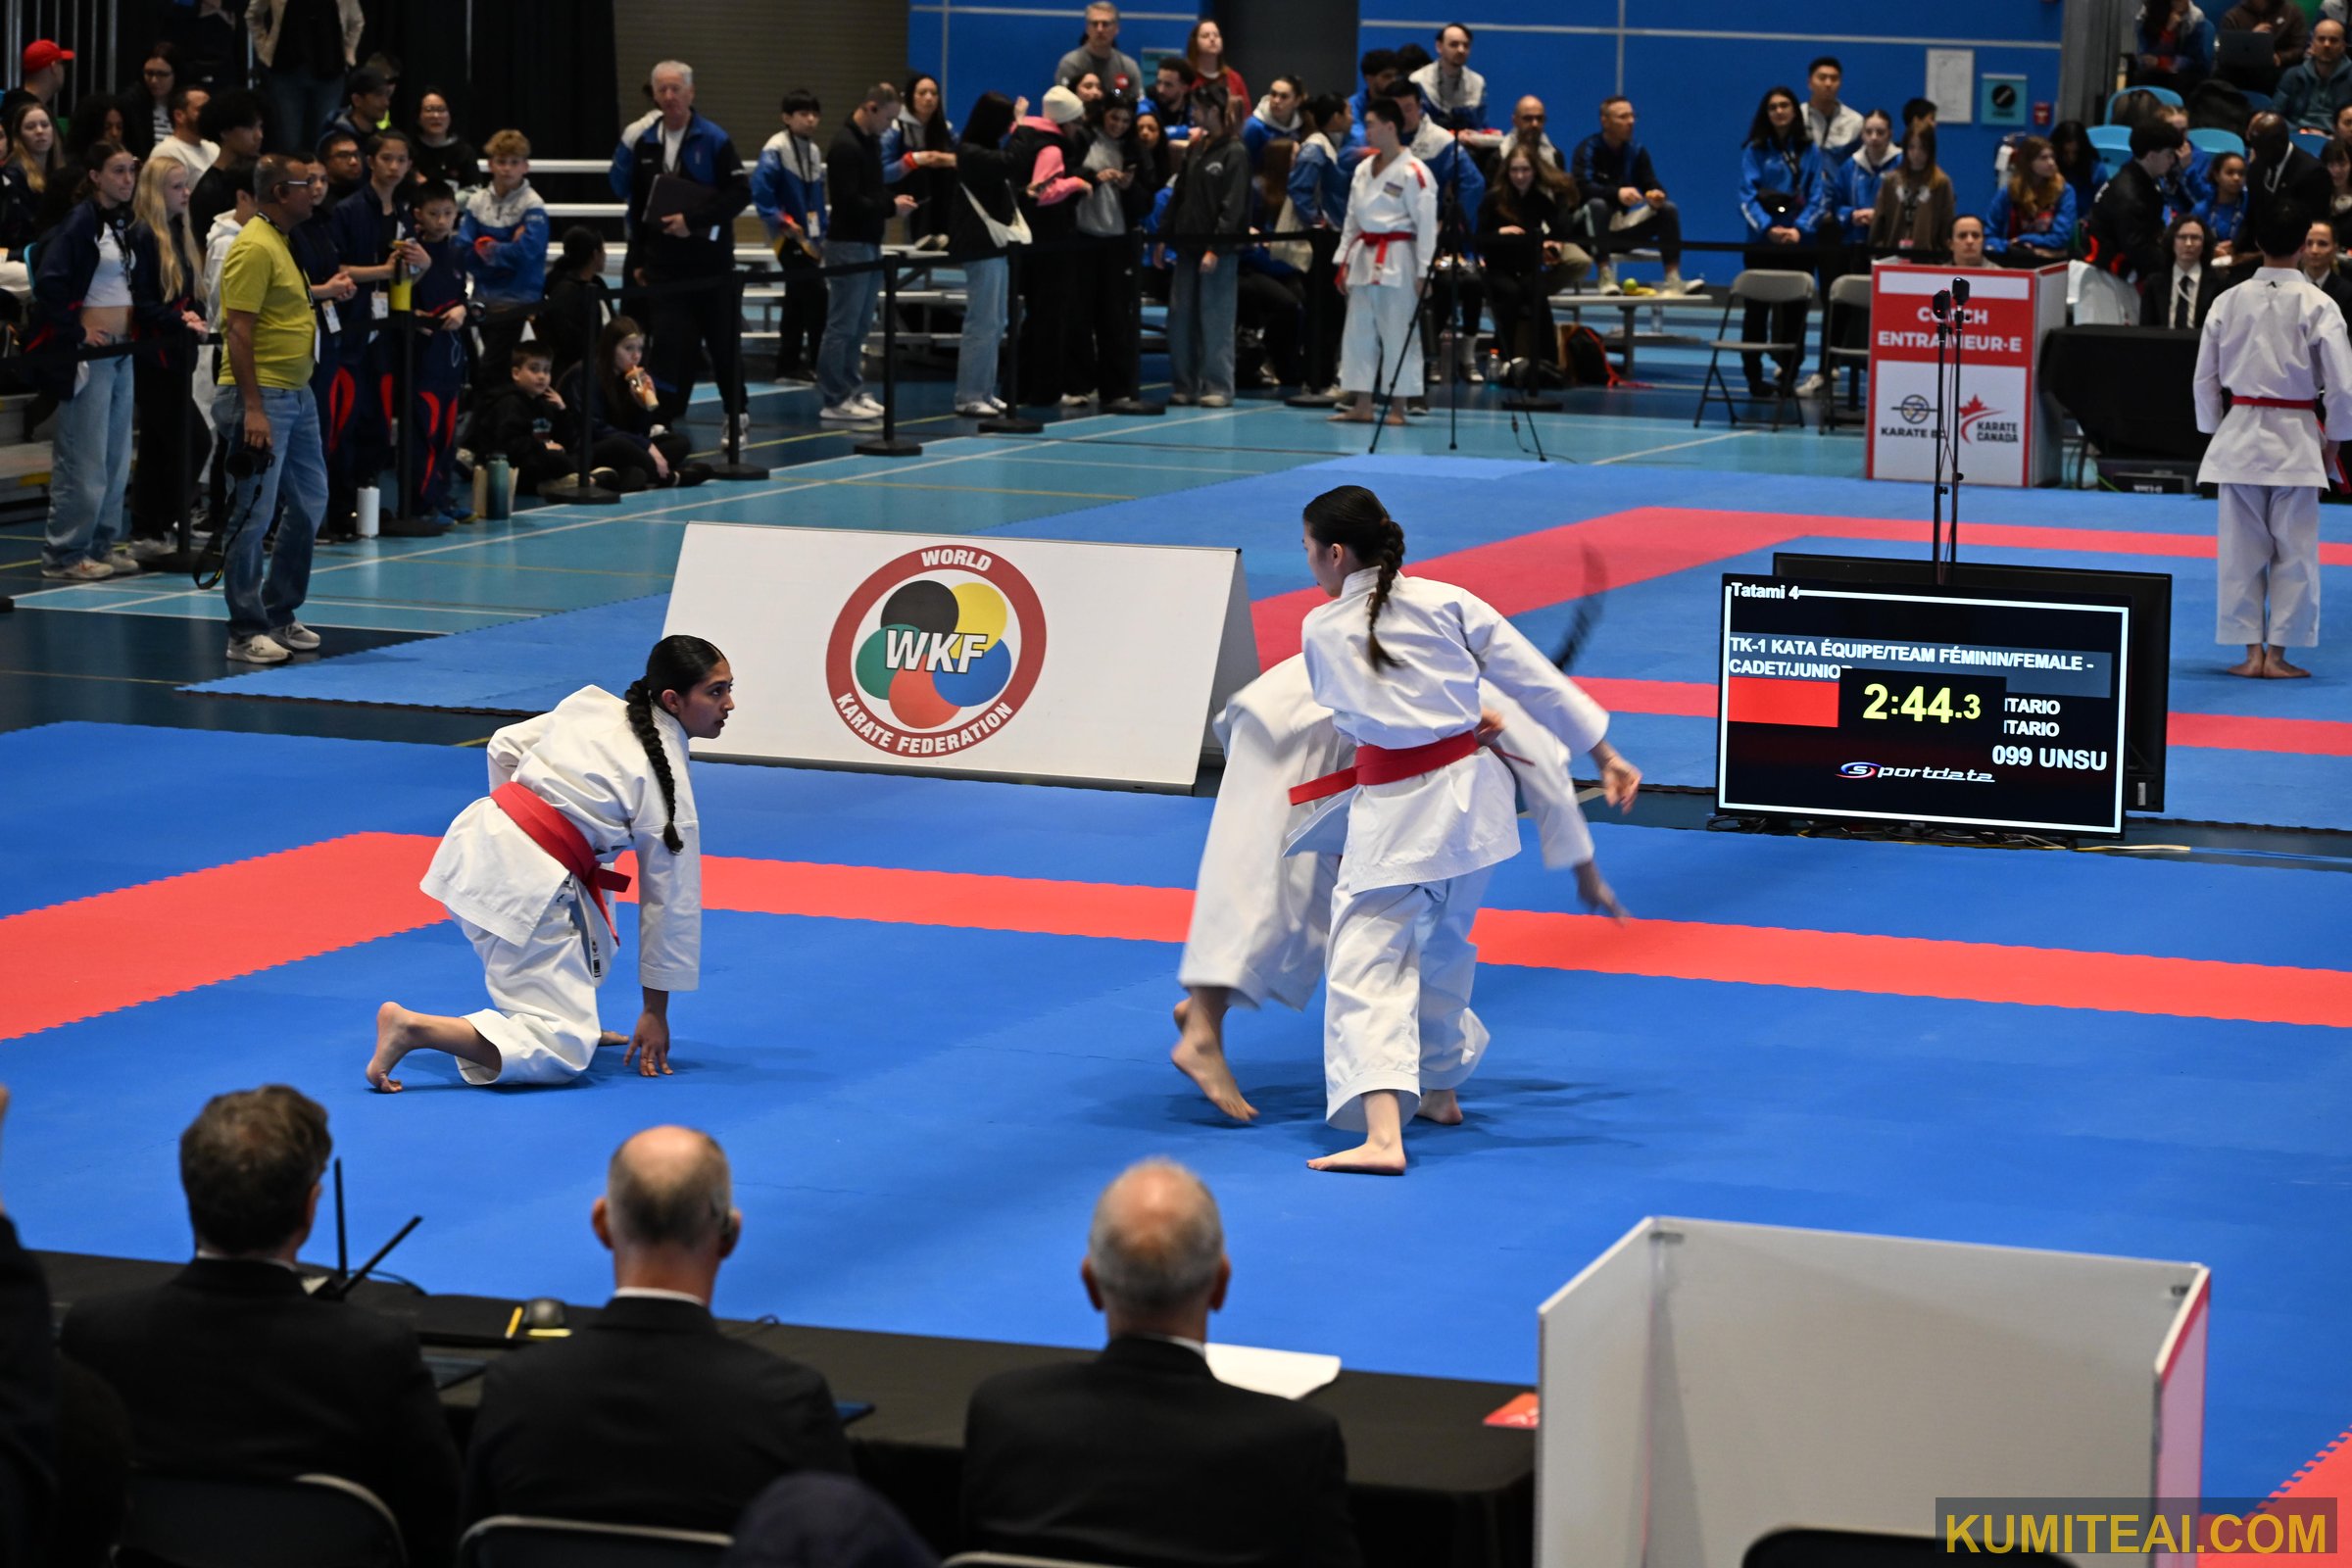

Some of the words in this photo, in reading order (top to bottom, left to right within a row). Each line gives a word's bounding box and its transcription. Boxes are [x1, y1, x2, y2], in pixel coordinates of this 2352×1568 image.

[1881, 426, 1927, 439] KARATE
[1977, 421, 2018, 432] KARATE
[1977, 432, 2019, 443] CANADA
[921, 549, 992, 571] WORLD
[1731, 582, 1786, 599] Tatami
[1788, 585, 1799, 600] 4
[886, 628, 988, 673] WKF
[1730, 637, 1765, 653] TK-1
[1772, 640, 1817, 656] KATA
[1821, 639, 1936, 662] ÉQUIPE/TEAM
[1939, 646, 2083, 670] FÉMININ/FEMALE
[1729, 659, 1852, 679] CADET/JUNIO
[1863, 683, 1981, 723] 2:44.3
[836, 693, 894, 748] KARATE
[897, 702, 1013, 754] FEDERATION
[1992, 745, 2033, 766] 099
[2039, 748, 2107, 771] UNSU
